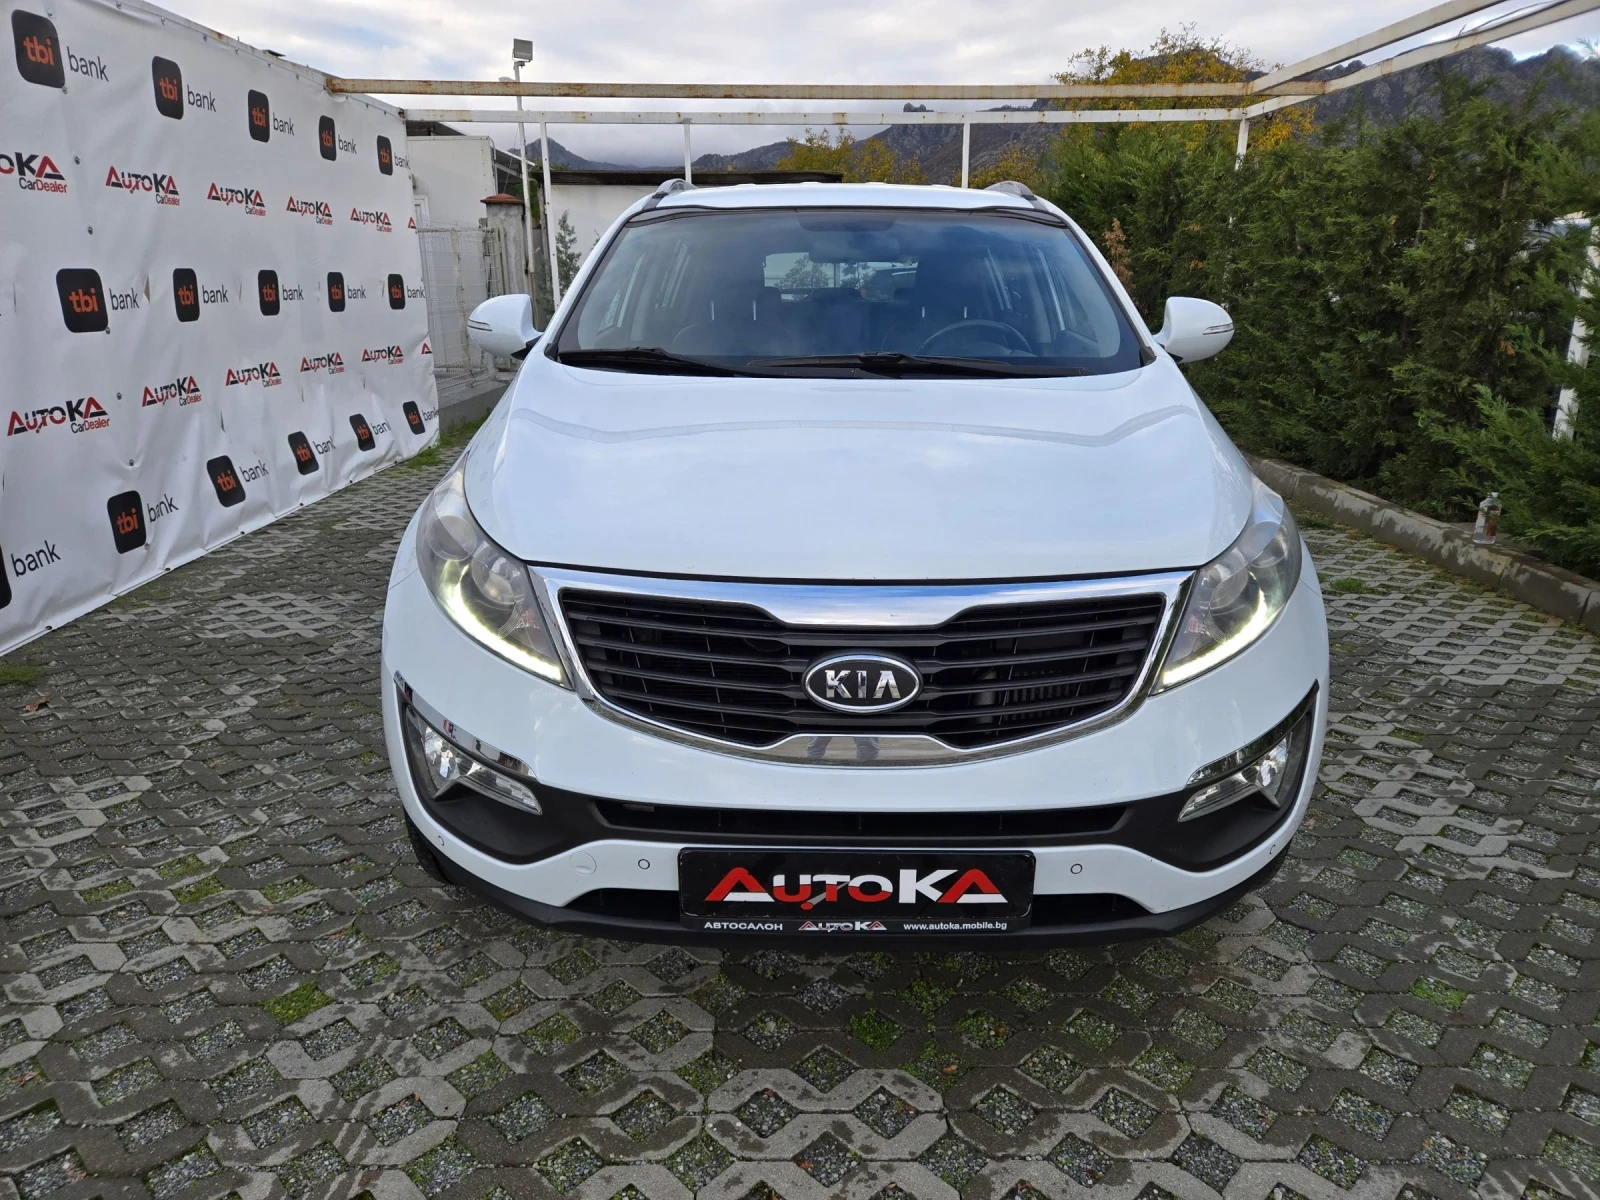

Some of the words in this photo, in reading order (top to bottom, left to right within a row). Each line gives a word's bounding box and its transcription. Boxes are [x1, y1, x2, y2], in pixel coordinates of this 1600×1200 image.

[23, 36, 55, 66] tbi
[67, 46, 109, 82] bank
[159, 76, 178, 101] tbi
[187, 84, 217, 112] bank
[252, 105, 266, 127] tbi
[273, 112, 295, 136] bank
[321, 130, 333, 149] tbi
[338, 134, 357, 154] bank
[380, 148, 389, 164] tbi
[394, 155, 410, 170] bank
[19, 178, 67, 194] CarDealer
[105, 165, 179, 195] AUTOKA
[155, 193, 180, 206] CarDealer
[207, 182, 265, 207] AUTOKA
[245, 206, 266, 217] CarDealer
[286, 196, 332, 217] AUTOKA
[350, 207, 392, 226] AUTOKA
[315, 216, 333, 226] CarDealer
[69, 287, 99, 312] tbi
[109, 288, 140, 311] bank
[178, 284, 195, 305] tbi
[202, 284, 229, 304] bank
[262, 284, 275, 301] tbi
[282, 284, 303, 301] bank
[330, 284, 342, 299] tbi
[347, 285, 366, 299] bank
[391, 285, 402, 299] tbi
[406, 285, 425, 299] bank
[300, 352, 344, 372] AUTOKA
[361, 345, 403, 362] AUTOKA
[225, 362, 281, 386] AUTOKA
[328, 366, 345, 375] CarDealer
[142, 376, 201, 407] AUTOKA
[262, 377, 282, 388] CarDealer
[178, 394, 202, 407] CarDealer
[7, 396, 109, 436] AUTOKA
[70, 417, 110, 434] CarDealer
[408, 410, 420, 425] tbi
[421, 407, 438, 421] bank
[356, 424, 370, 440] tbi
[296, 443, 312, 462] tbi
[217, 470, 237, 492] tbi
[239, 459, 269, 483] bank
[116, 507, 139, 535] tbi
[11, 540, 61, 578] bank
[825, 669, 901, 699] KIA
[704, 867, 1009, 911] AUTOKA
[704, 921, 783, 931] АВТОСАЛОН
[798, 920, 888, 933] AUTOKA
[903, 921, 1008, 931] www.autoka.mobile.bg
